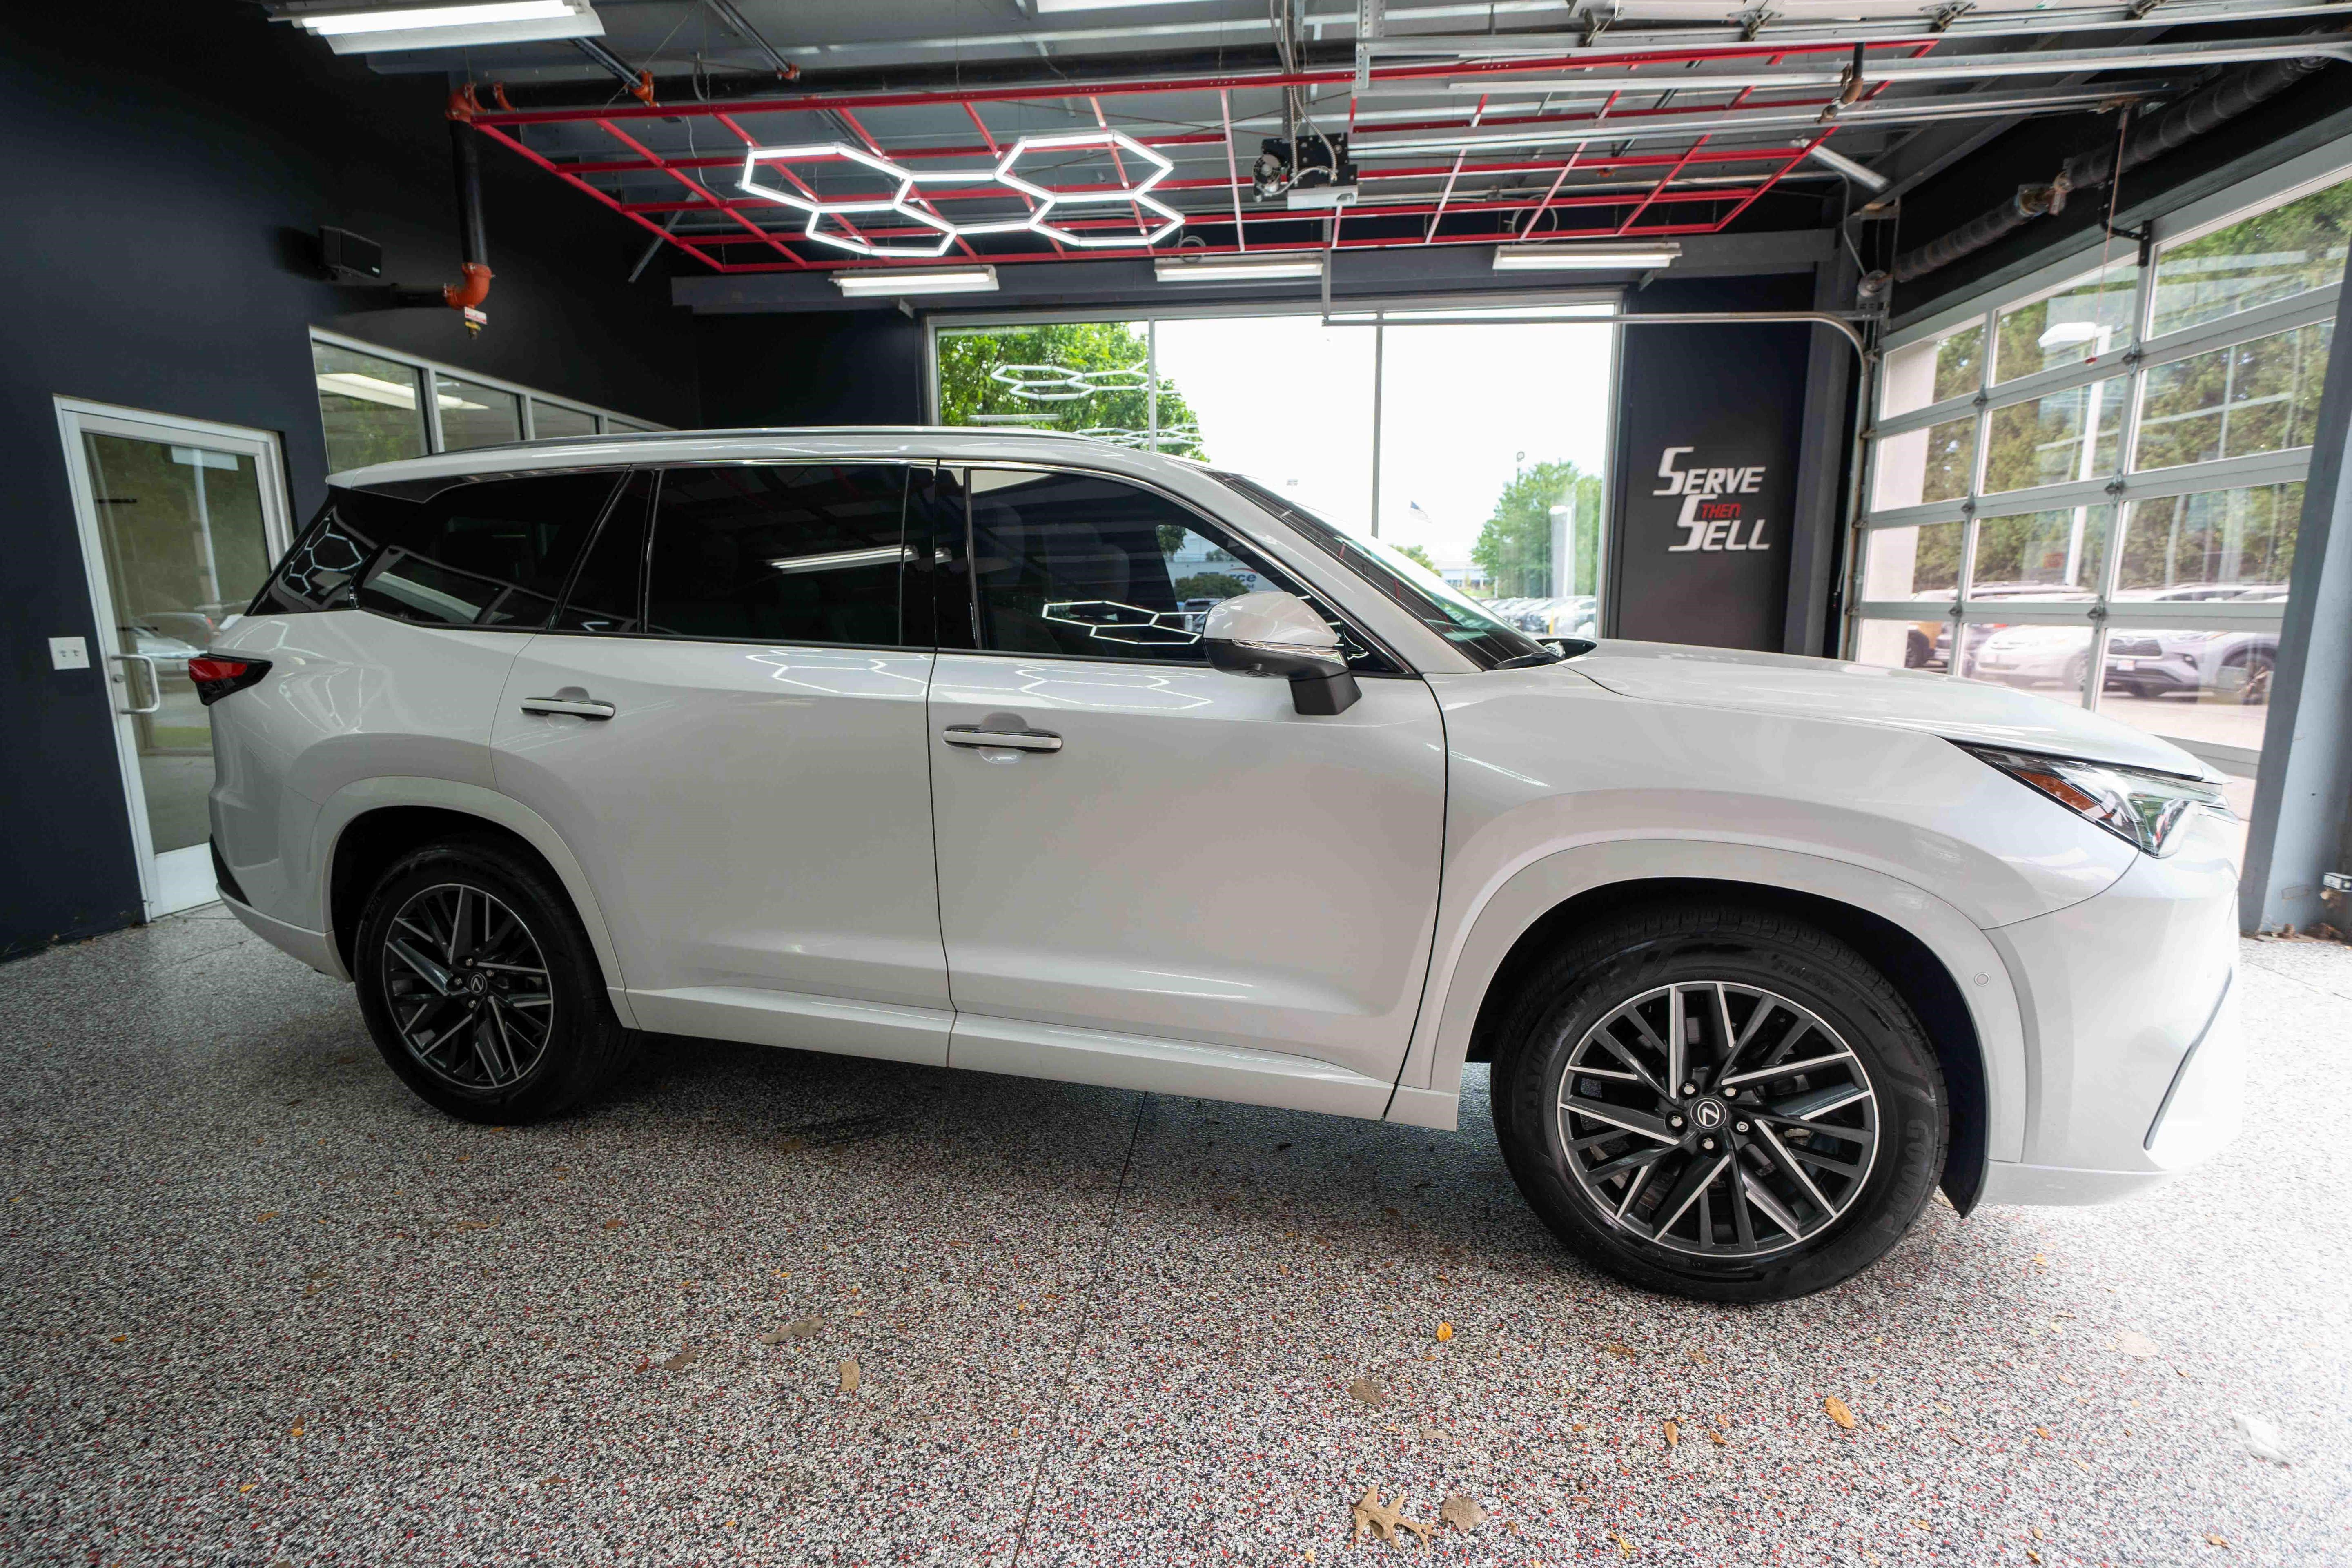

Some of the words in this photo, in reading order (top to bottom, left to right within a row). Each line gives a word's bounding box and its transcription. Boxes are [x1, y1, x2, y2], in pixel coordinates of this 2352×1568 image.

[1653, 447, 1766, 495] SERVE
[1668, 494, 1770, 551] SELL
[1702, 503, 1741, 518] THEN
